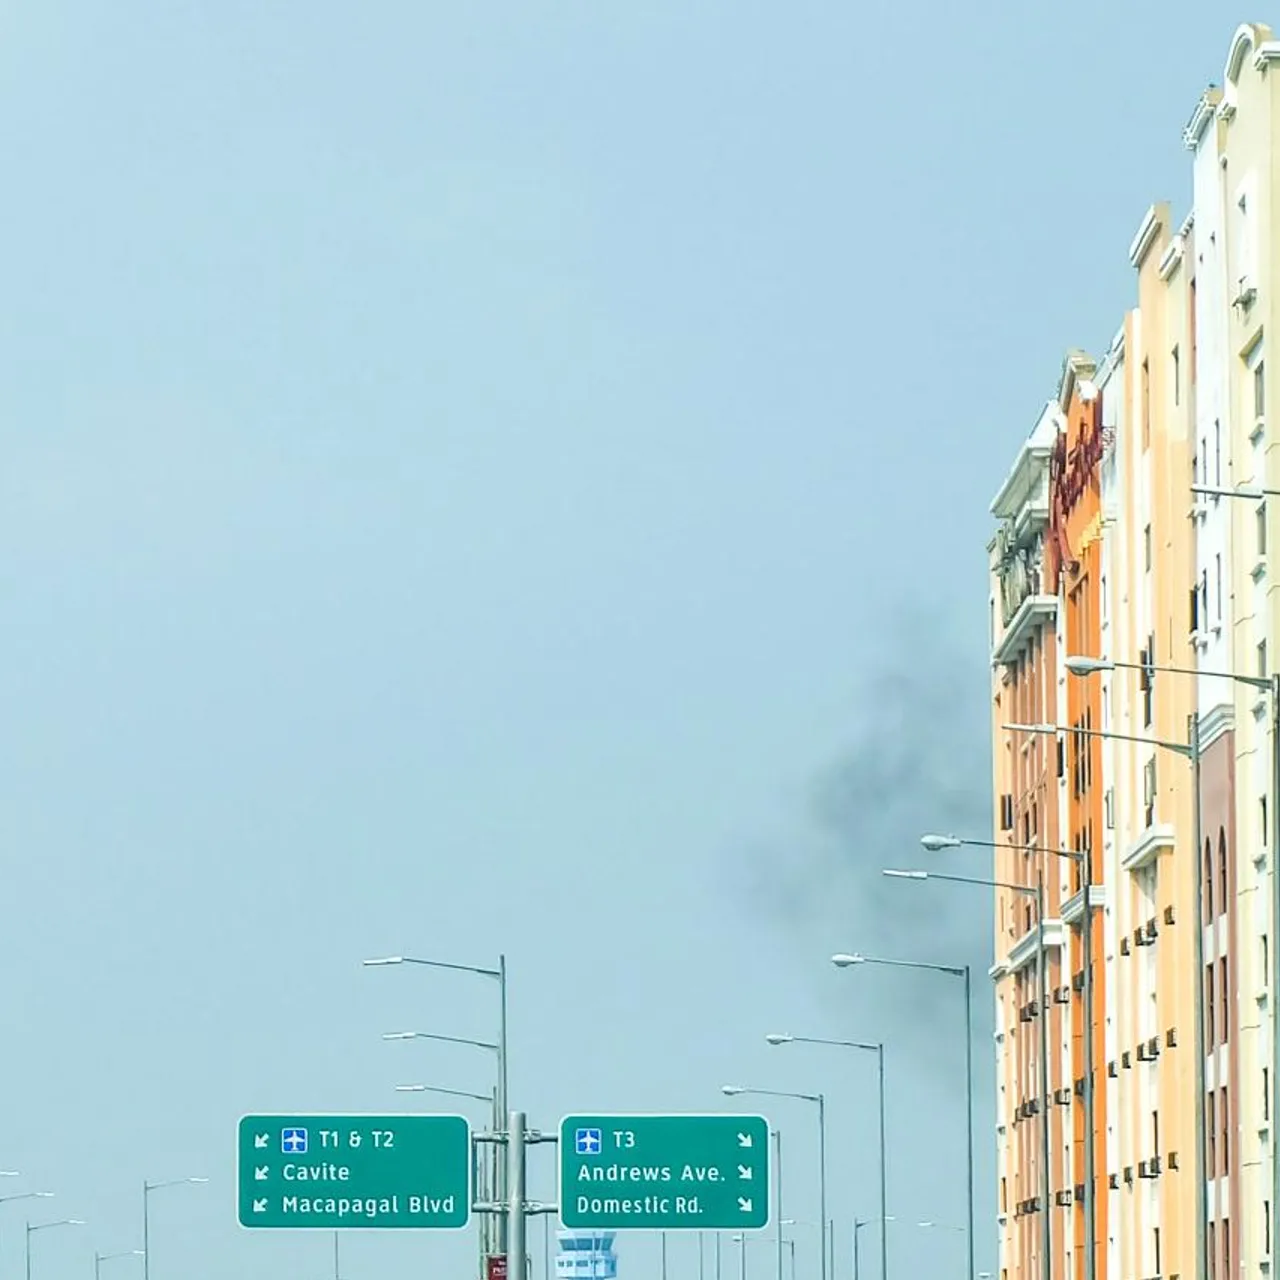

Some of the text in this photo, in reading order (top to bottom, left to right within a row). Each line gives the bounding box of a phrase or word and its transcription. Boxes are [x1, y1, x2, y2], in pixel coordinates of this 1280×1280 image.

[319, 1130, 395, 1148] T1 & T2
[613, 1130, 636, 1148] T3
[282, 1162, 351, 1181] Cavite
[577, 1163, 726, 1182] Andrews Ave.
[282, 1195, 455, 1218] Macapagal Blvd
[577, 1196, 704, 1214] Domestic Rd.
